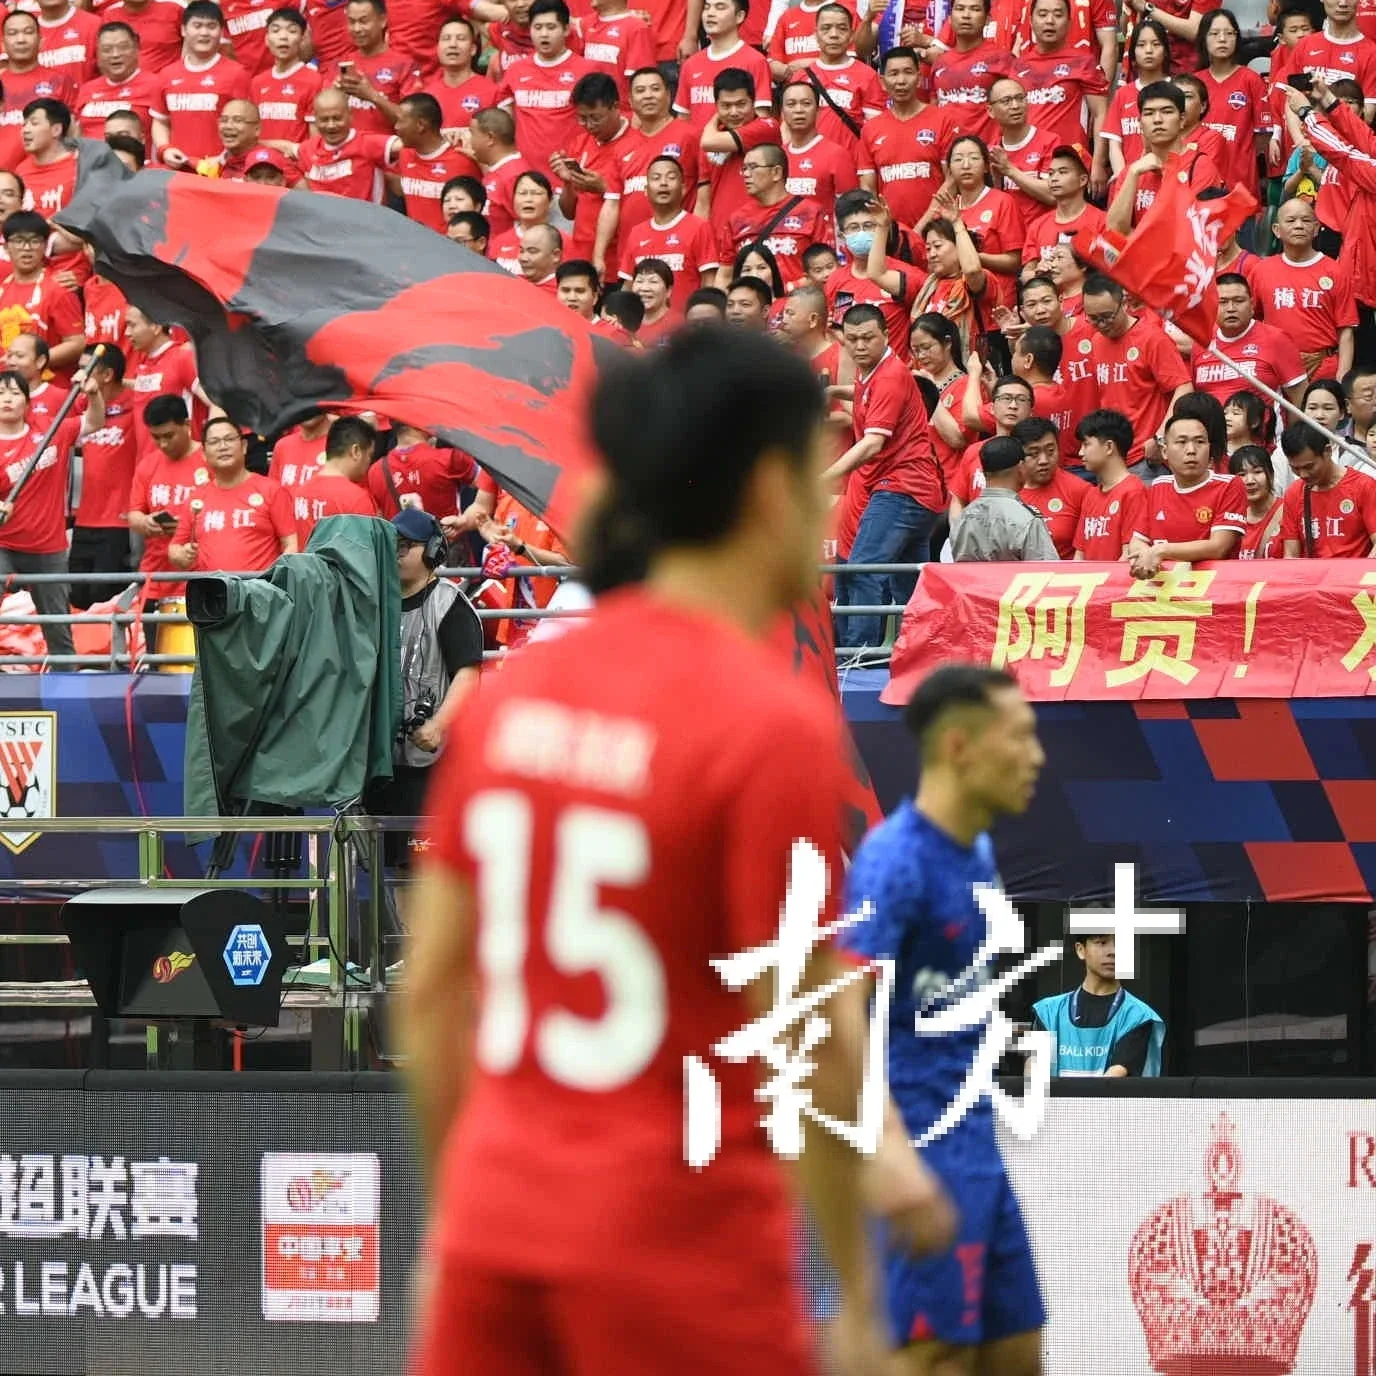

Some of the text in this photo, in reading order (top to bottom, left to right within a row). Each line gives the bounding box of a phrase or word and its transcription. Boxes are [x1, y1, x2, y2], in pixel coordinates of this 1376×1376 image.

[881, 162, 930, 182] 梅州客家
[1274, 286, 1324, 309] 梅江
[1097, 362, 1127, 384] 梅江
[204, 509, 254, 531] 梅江
[461, 787, 670, 1094] 15
[1059, 1045, 1083, 1057] BALL
[15, 1260, 198, 1318] LEAGUE
